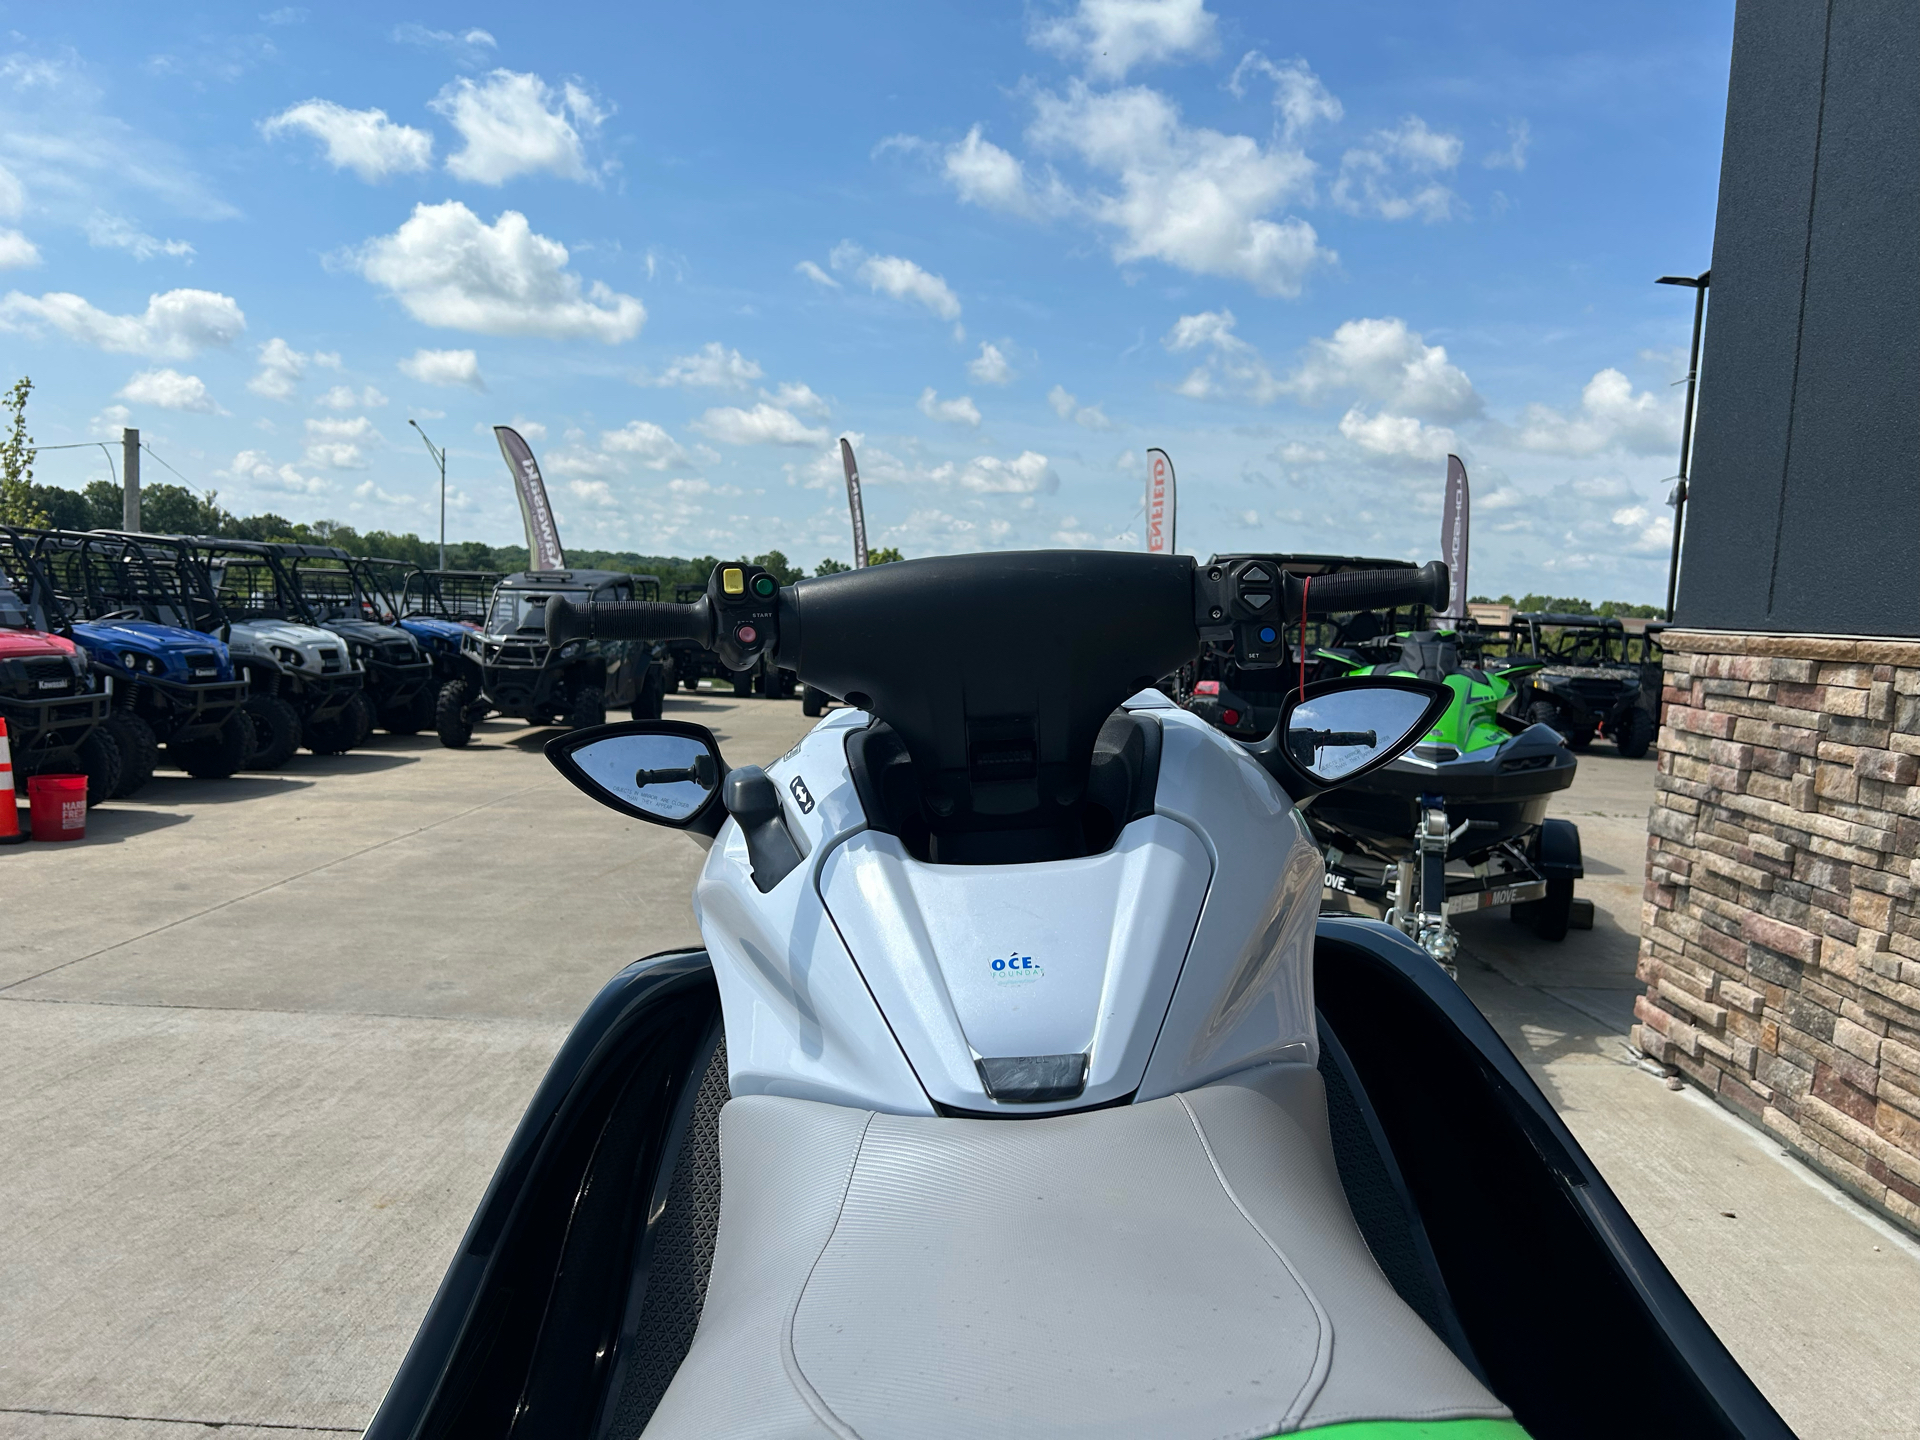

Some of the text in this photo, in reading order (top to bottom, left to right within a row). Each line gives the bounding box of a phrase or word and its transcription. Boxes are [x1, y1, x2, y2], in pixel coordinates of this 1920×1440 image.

[613, 785, 632, 794] OBJECTS
[641, 791, 658, 800] MIRROR
[672, 800, 690, 808] CLOSER
[655, 802, 673, 810] APPEAR
[1324, 873, 1346, 890] OVE
[1492, 889, 1517, 905] MOVE
